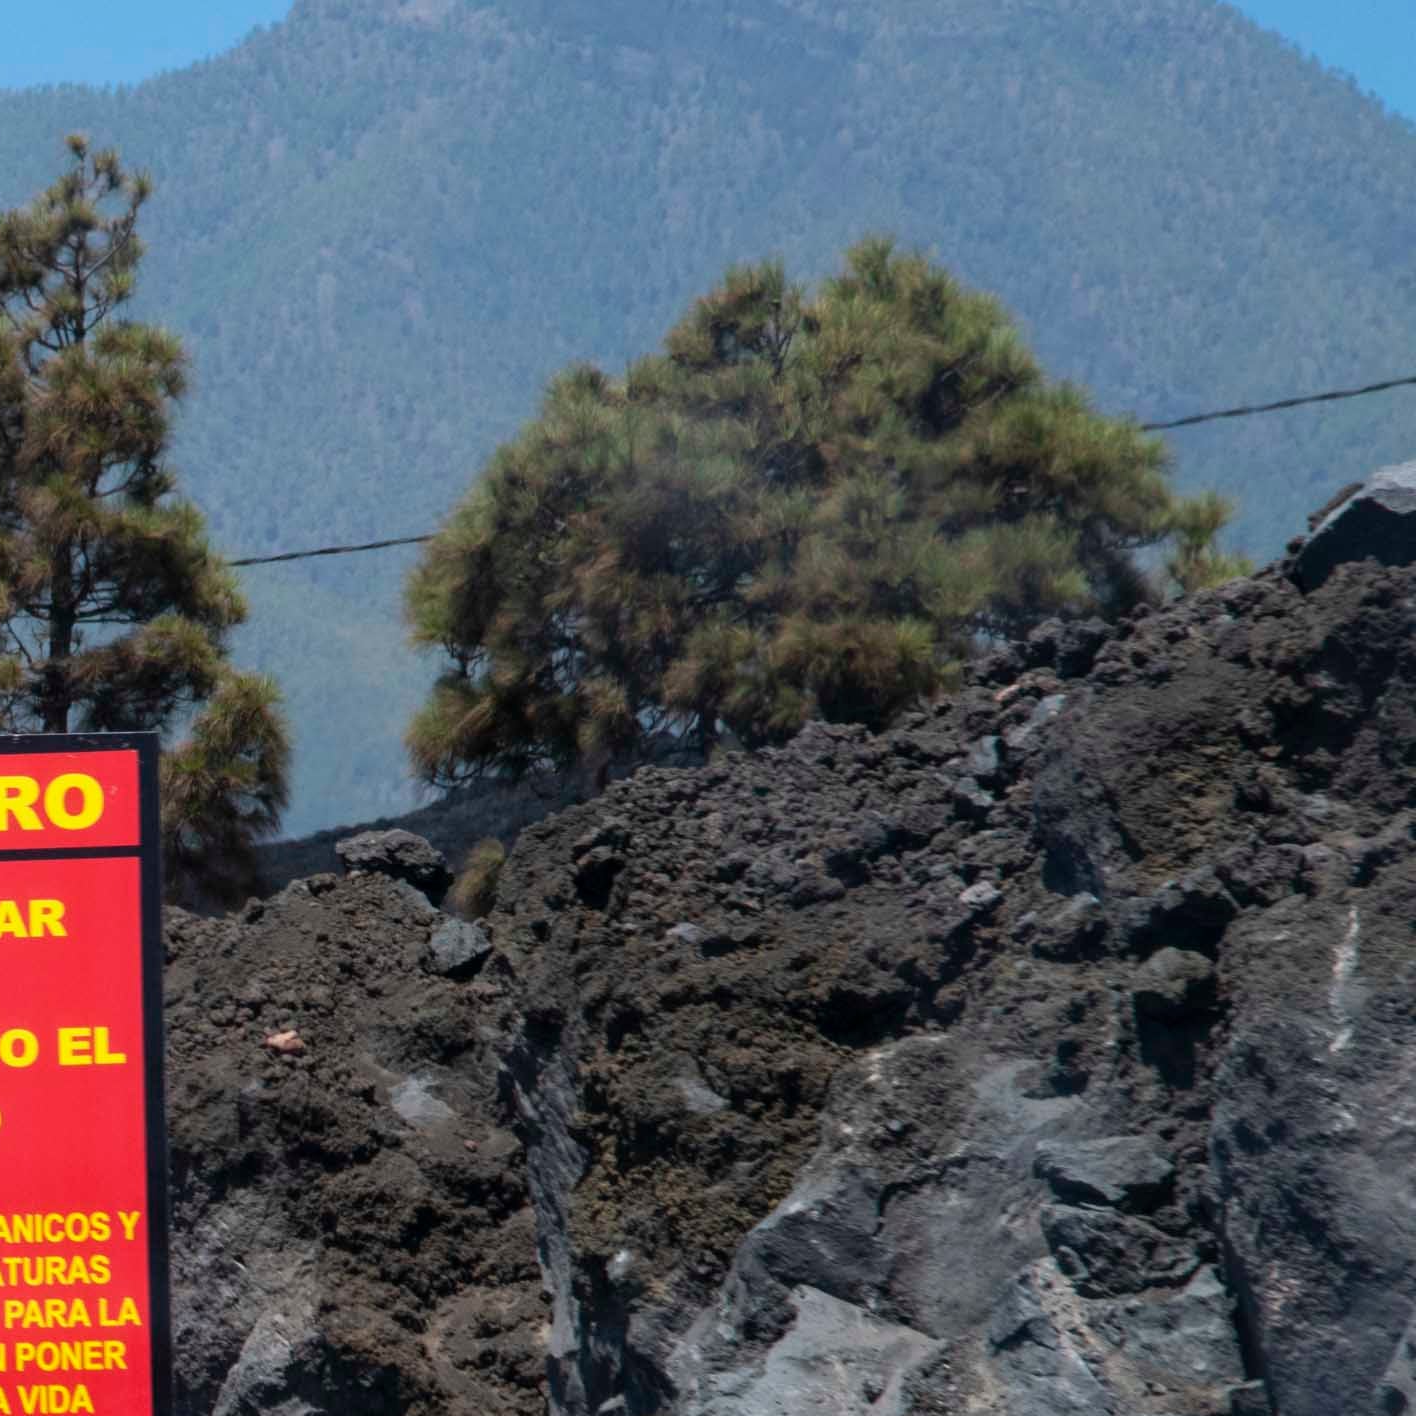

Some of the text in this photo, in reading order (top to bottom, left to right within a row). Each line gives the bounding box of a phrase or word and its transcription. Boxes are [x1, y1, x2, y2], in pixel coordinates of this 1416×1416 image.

[57, 1026, 127, 1066] EL
[118, 1211, 140, 1240] Y
[4, 1298, 92, 1329] PARA
[98, 1297, 142, 1327] LA
[15, 1340, 127, 1372] PONER
[17, 1384, 94, 1415] VIDA
